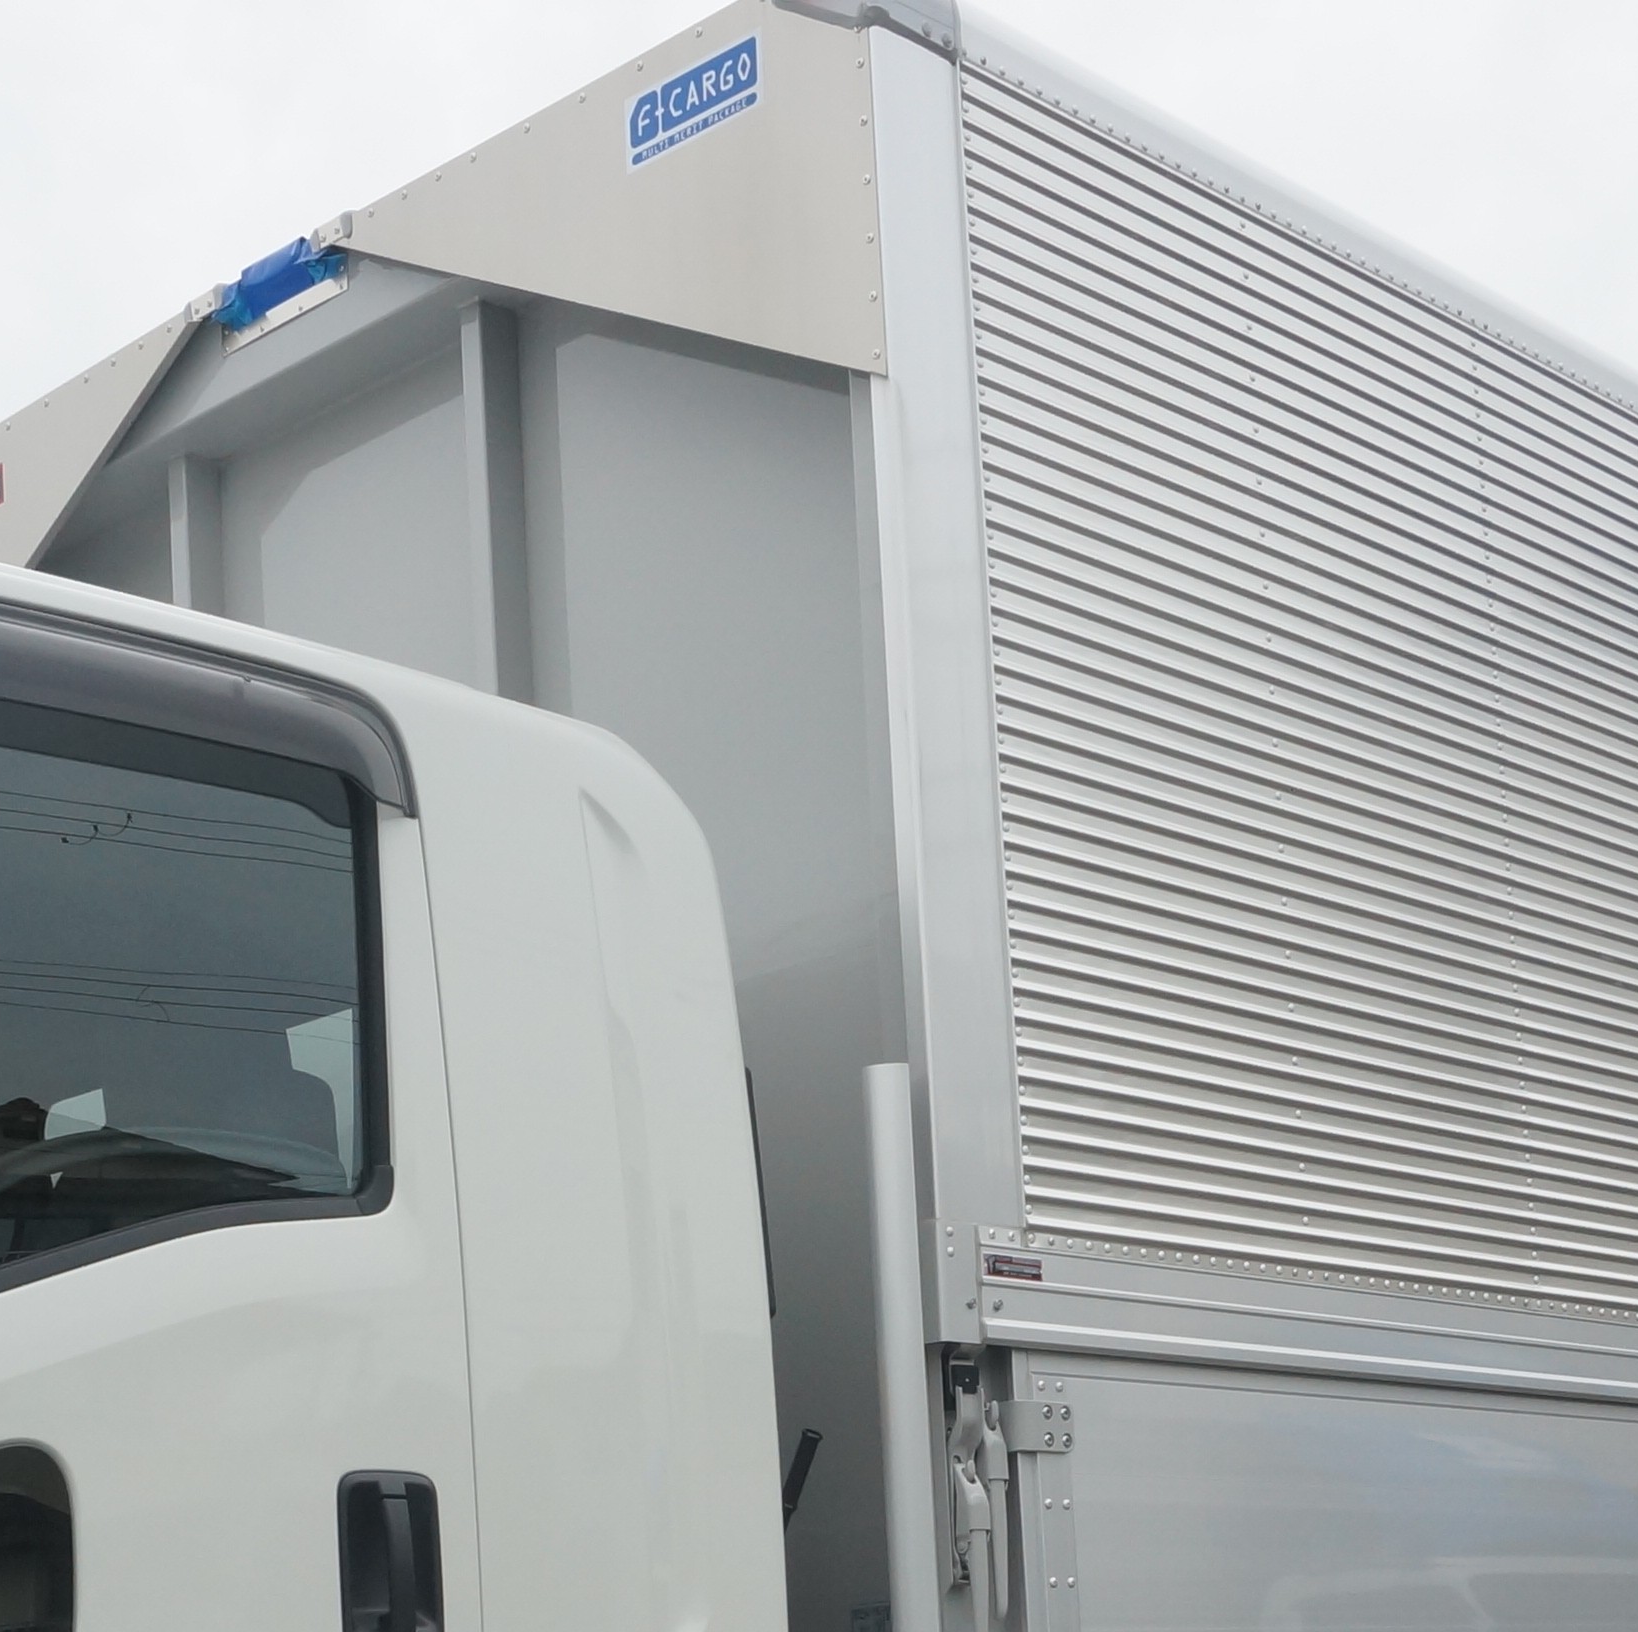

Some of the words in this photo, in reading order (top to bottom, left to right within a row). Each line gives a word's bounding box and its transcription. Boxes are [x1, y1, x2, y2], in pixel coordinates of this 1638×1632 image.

[637, 51, 752, 137] F-CARGO
[641, 138, 669, 160] MULTI
[673, 121, 703, 142] MERIT
[707, 97, 748, 125] PACKAGE
